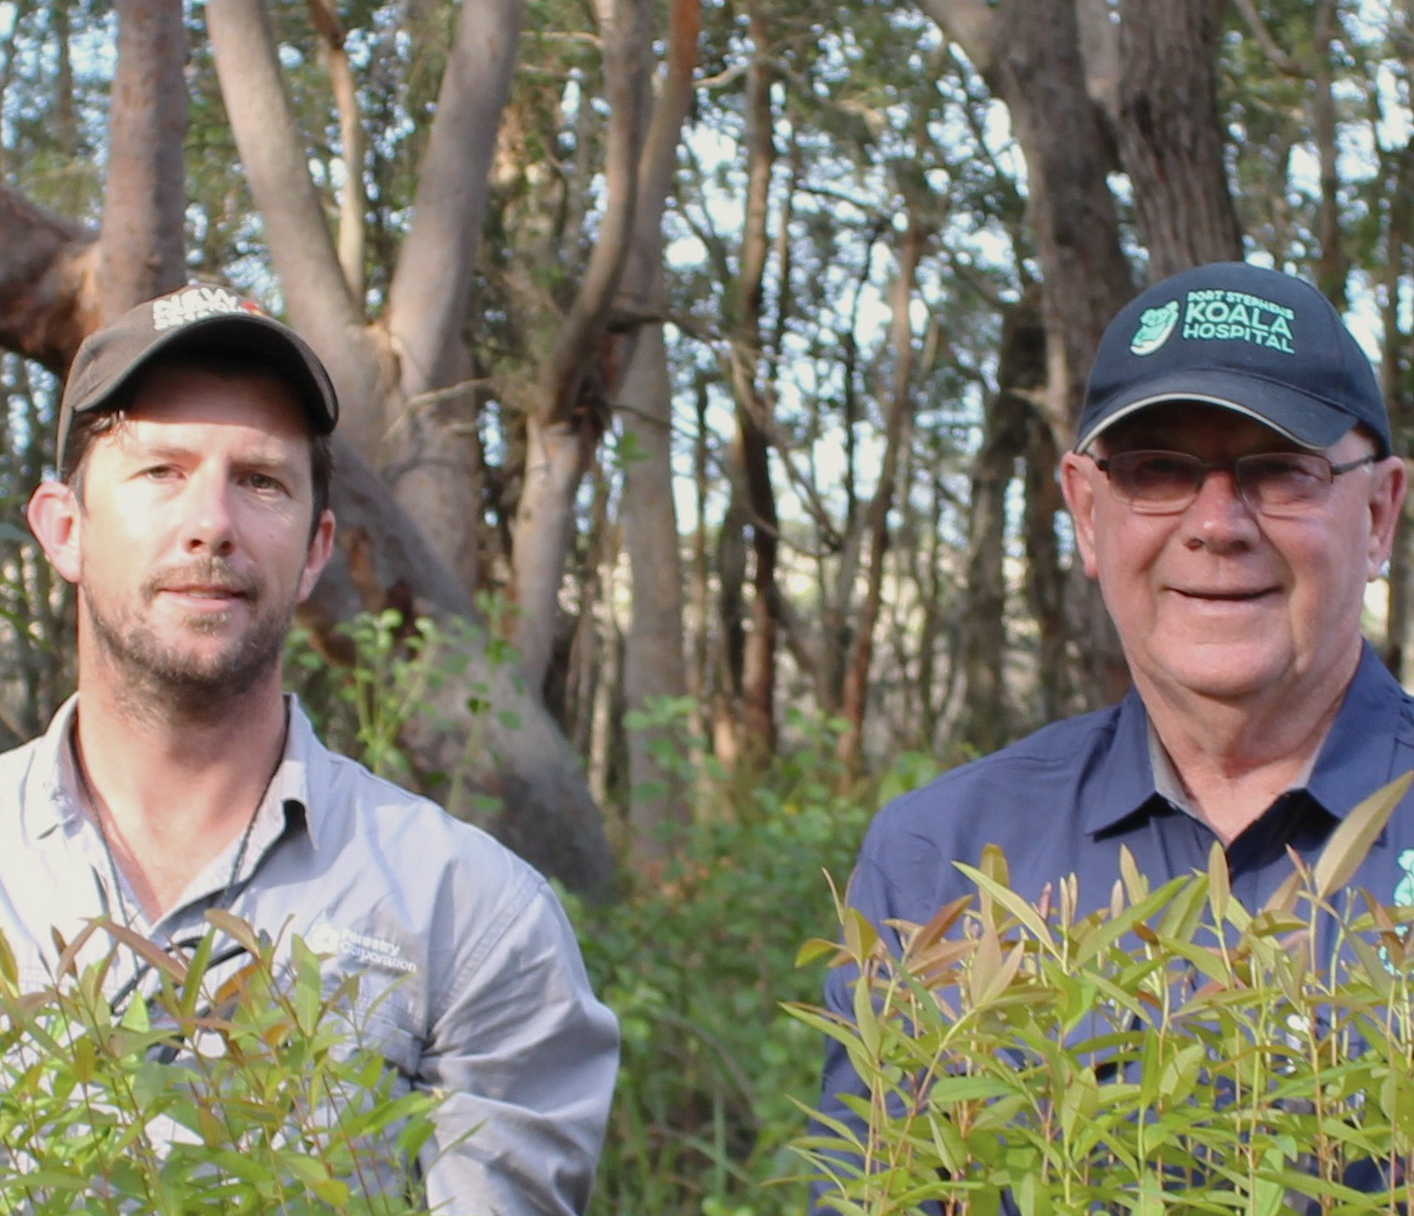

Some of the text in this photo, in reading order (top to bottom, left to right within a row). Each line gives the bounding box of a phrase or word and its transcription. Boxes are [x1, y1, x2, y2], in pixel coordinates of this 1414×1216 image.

[1187, 289, 1225, 302] PORT
[1185, 301, 1293, 340] KOALA
[1182, 322, 1296, 354] HOSPITAL
[340, 940, 418, 974] Corporation
[341, 929, 401, 957] Forestry
